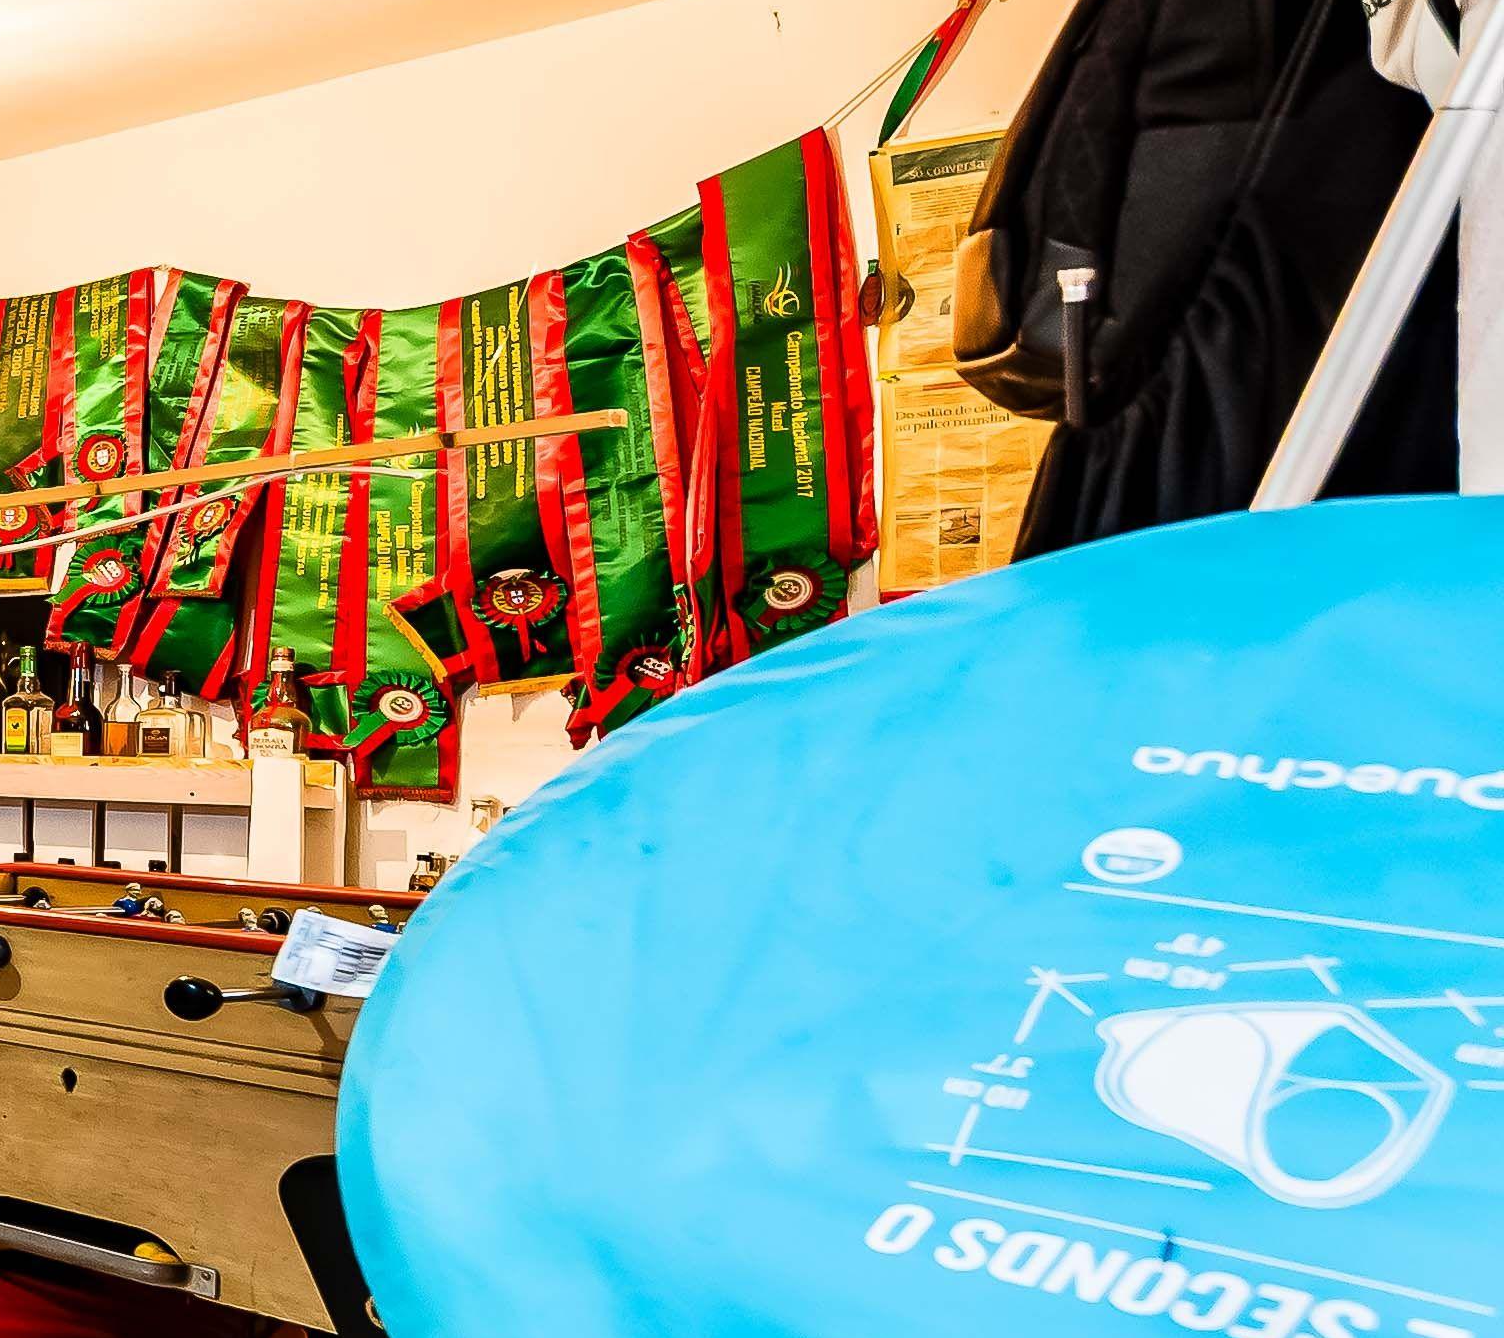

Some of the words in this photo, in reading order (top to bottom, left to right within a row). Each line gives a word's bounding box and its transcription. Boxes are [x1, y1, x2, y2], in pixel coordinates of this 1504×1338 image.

[745, 366, 765, 416] CAMPEÃO
[784, 331, 805, 409] Campeonato
[771, 401, 789, 431] Mixed
[791, 412, 811, 466] Nacional
[913, 416, 949, 433] palco
[952, 412, 1010, 427] mundial
[747, 419, 766, 470] NACIONAL
[796, 468, 814, 498] 2017
[410, 481, 425, 550] Campeonato
[413, 552, 426, 584] Nacio
